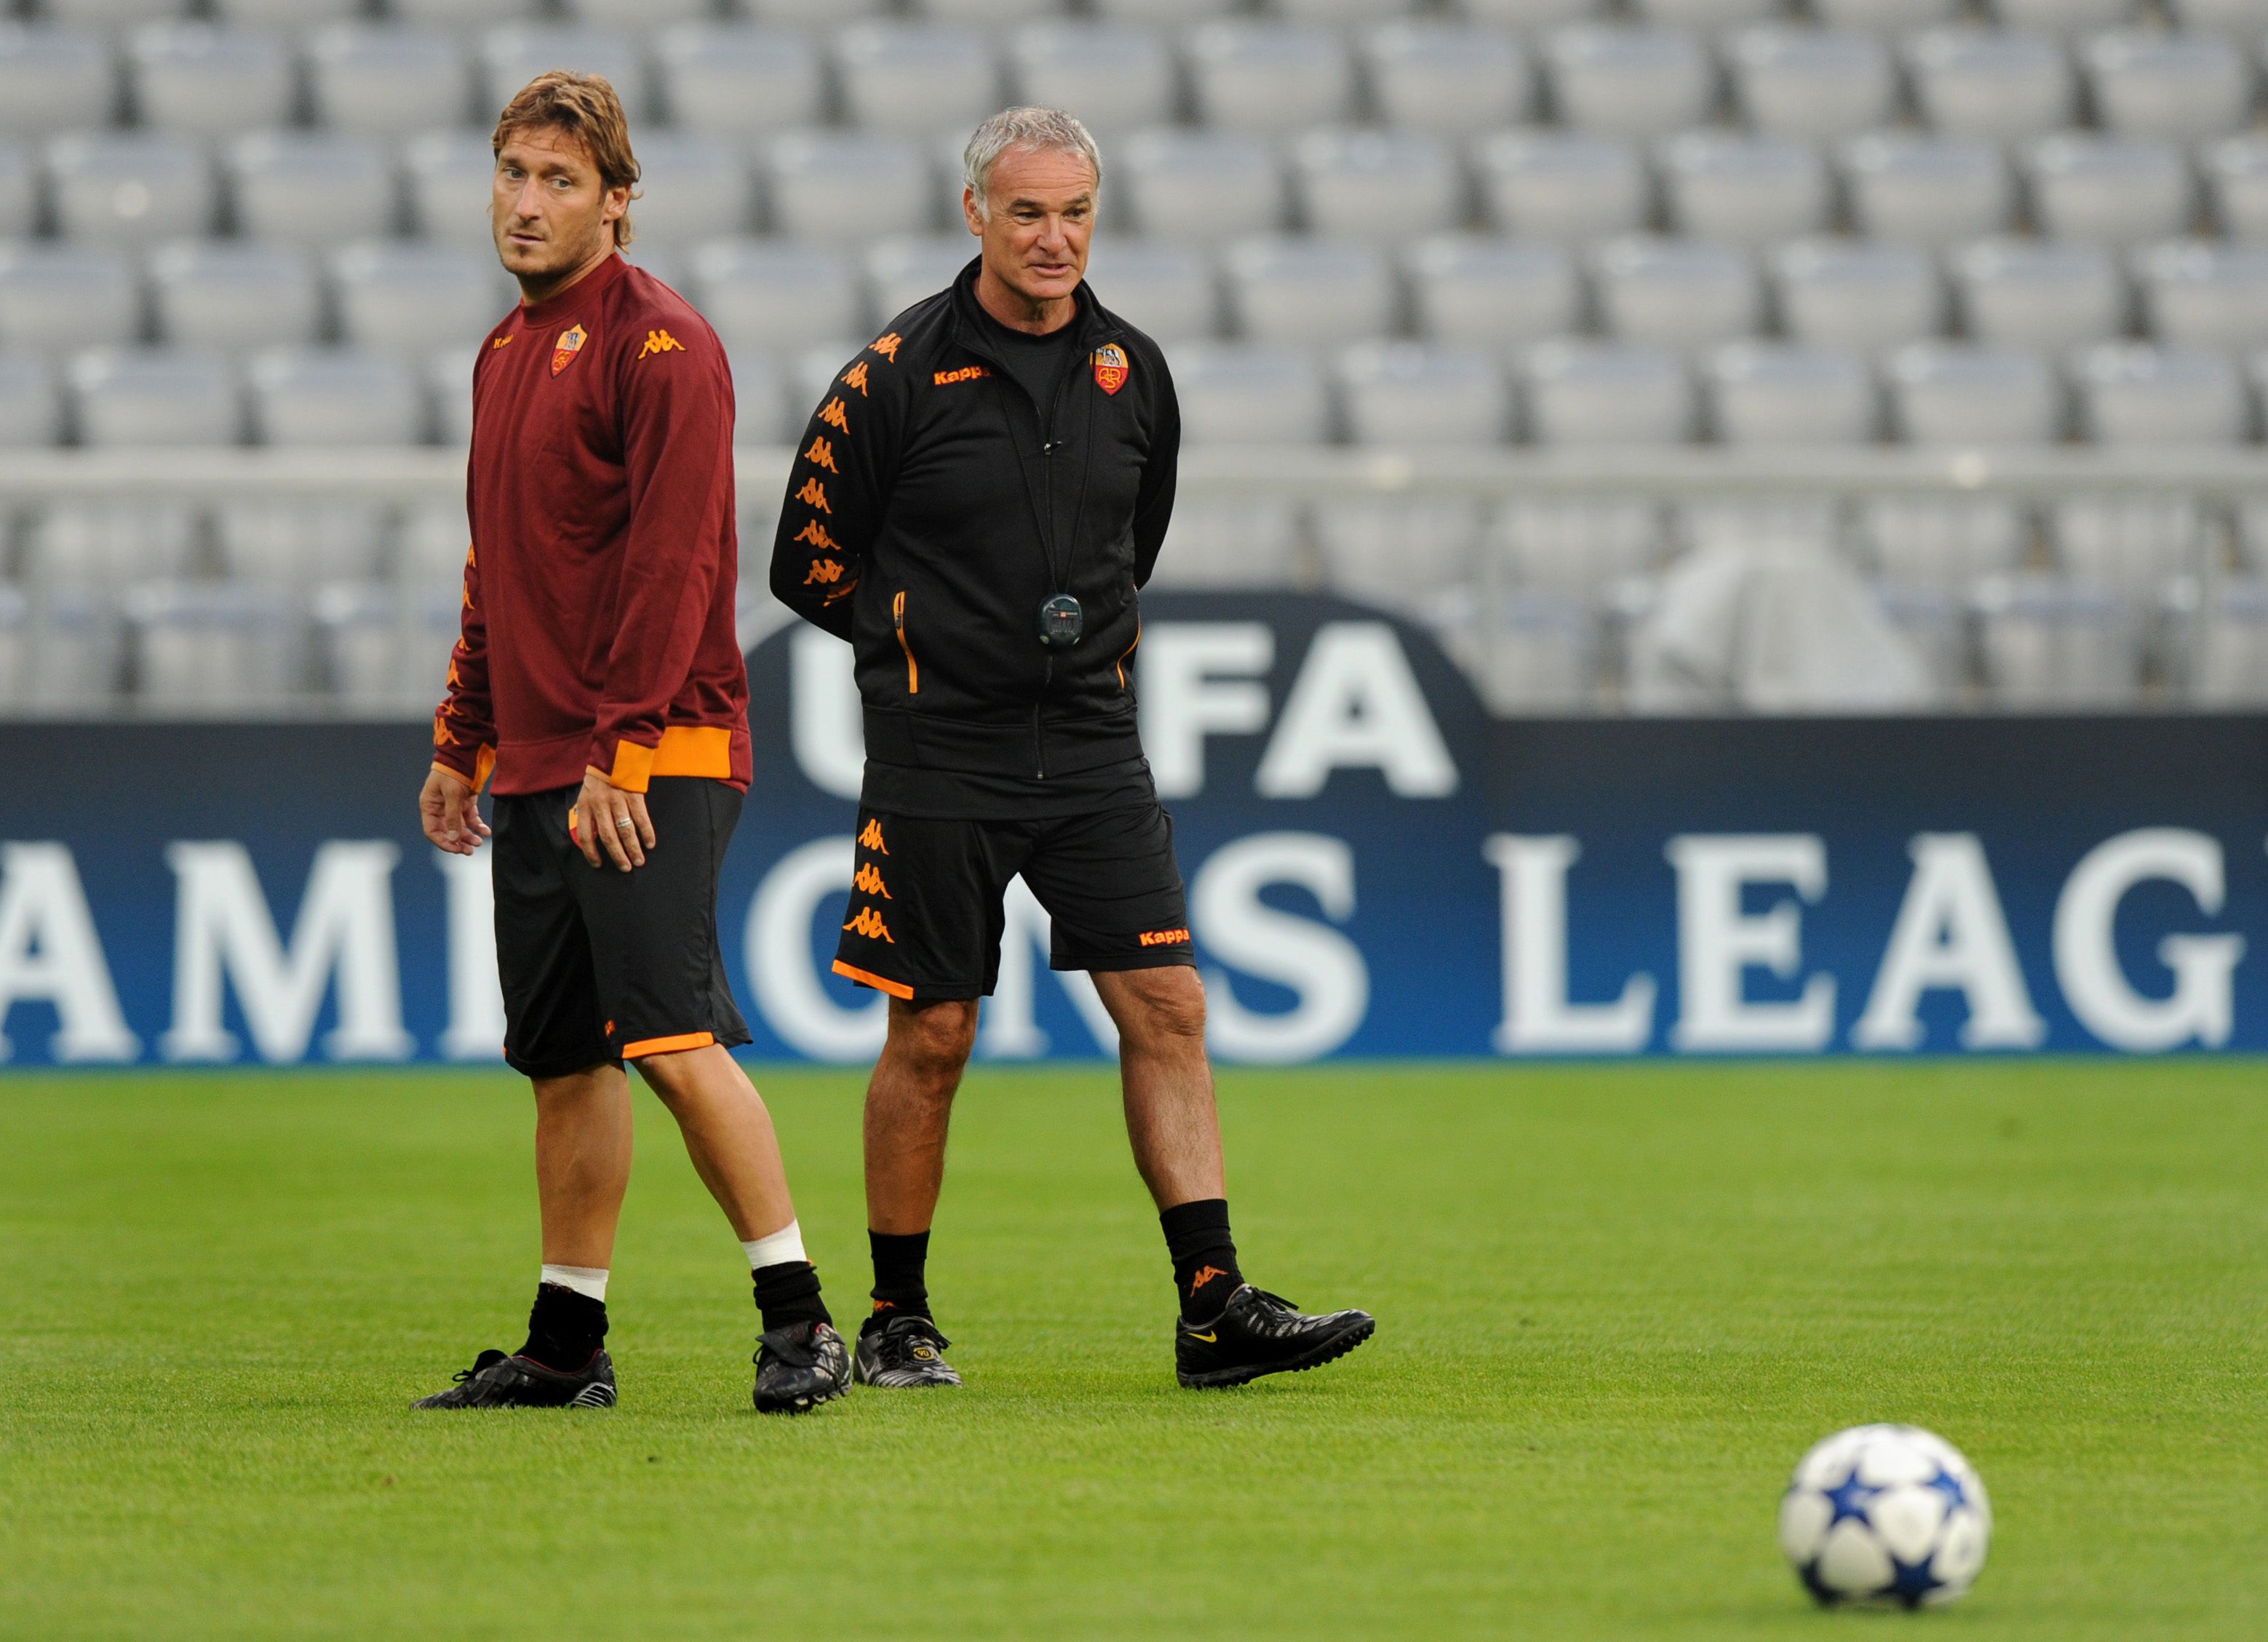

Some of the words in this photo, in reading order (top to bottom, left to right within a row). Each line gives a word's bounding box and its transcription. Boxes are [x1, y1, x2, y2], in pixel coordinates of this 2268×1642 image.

[790, 622, 1457, 798] UFA
[0, 831, 1369, 1063] AMONS
[1483, 827, 2268, 1052] LEAG
[1139, 929, 1190, 946] Kappa
